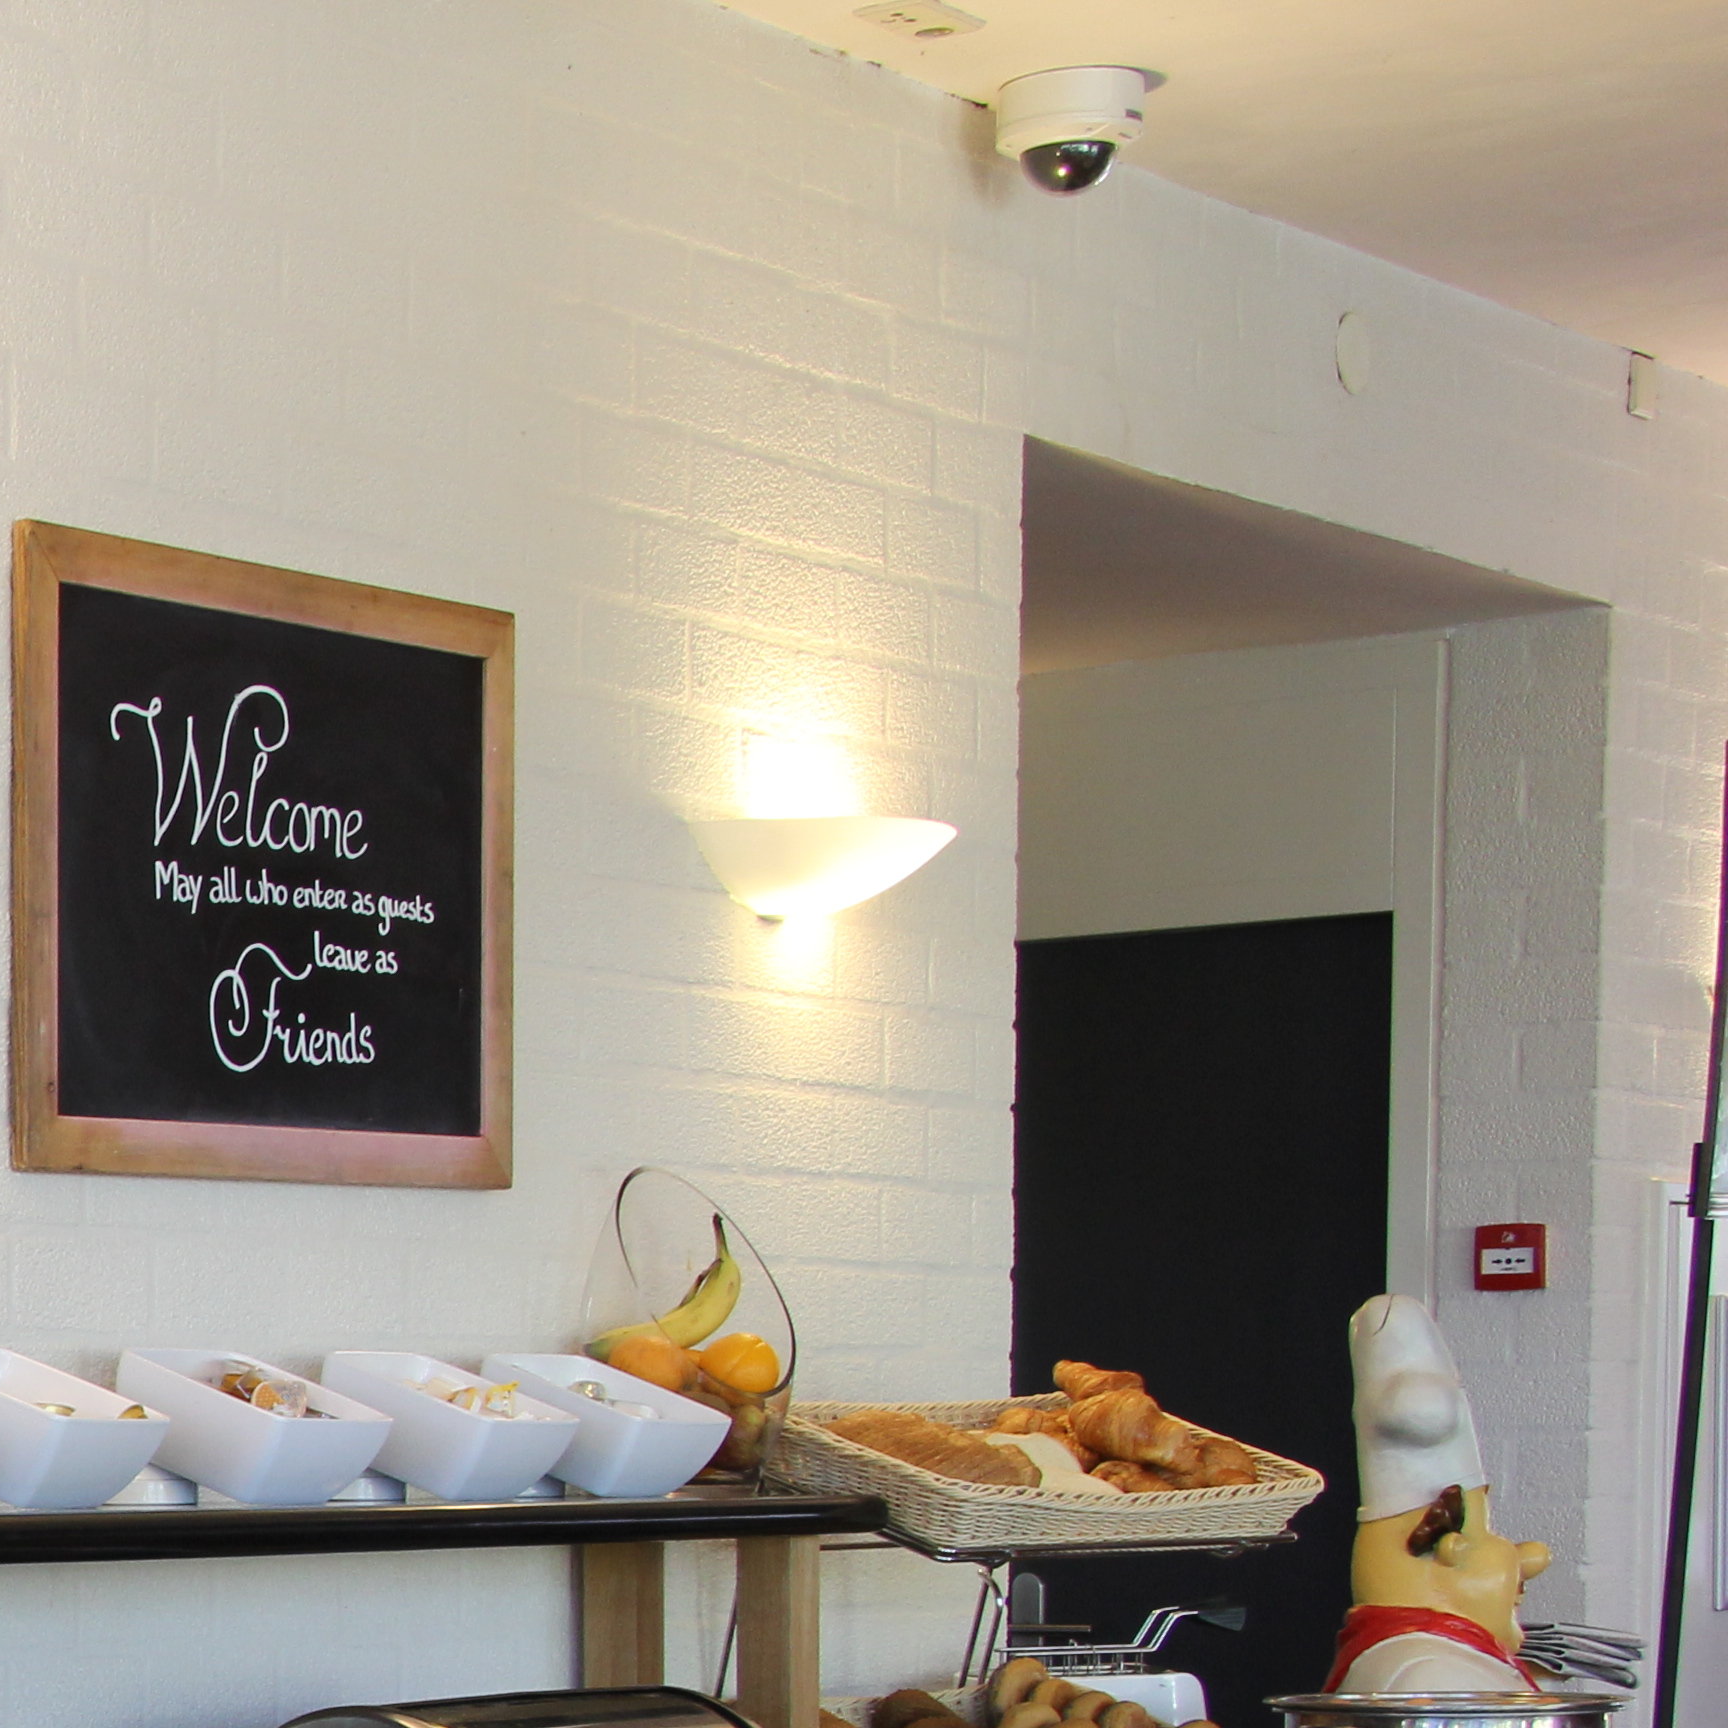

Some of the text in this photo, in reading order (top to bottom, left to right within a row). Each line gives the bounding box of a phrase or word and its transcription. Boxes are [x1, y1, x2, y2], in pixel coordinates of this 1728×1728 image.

[110, 684, 368, 860] Welcome
[154, 860, 435, 937] May all who enter as guests
[313, 931, 399, 975] leave as
[209, 942, 376, 1073] Friends
